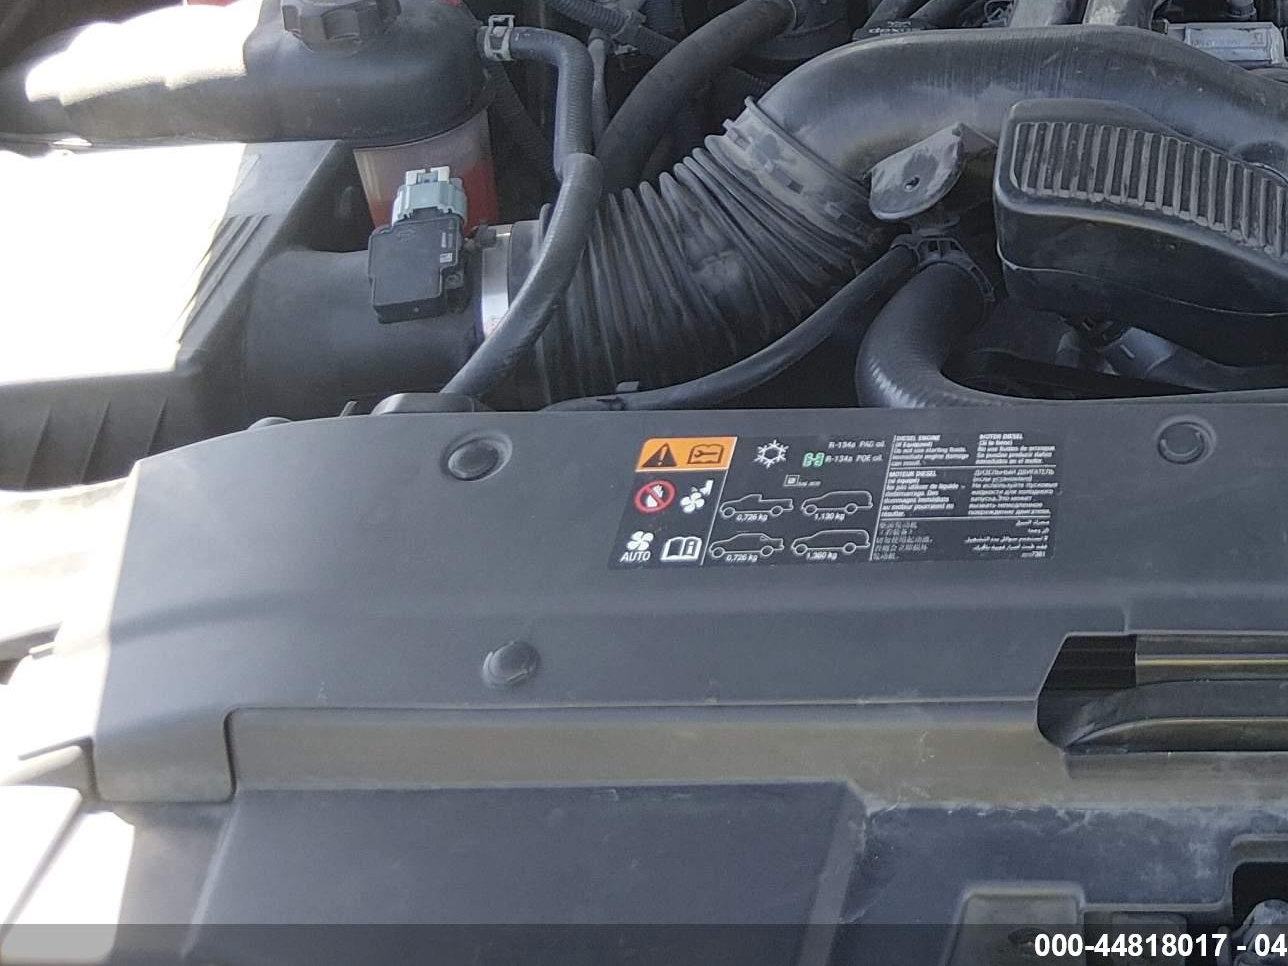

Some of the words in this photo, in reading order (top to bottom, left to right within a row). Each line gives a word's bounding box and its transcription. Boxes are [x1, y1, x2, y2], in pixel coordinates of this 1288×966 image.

[757, 513, 768, 522] kg
[834, 512, 845, 521] kg
[619, 550, 651, 562] AUTO
